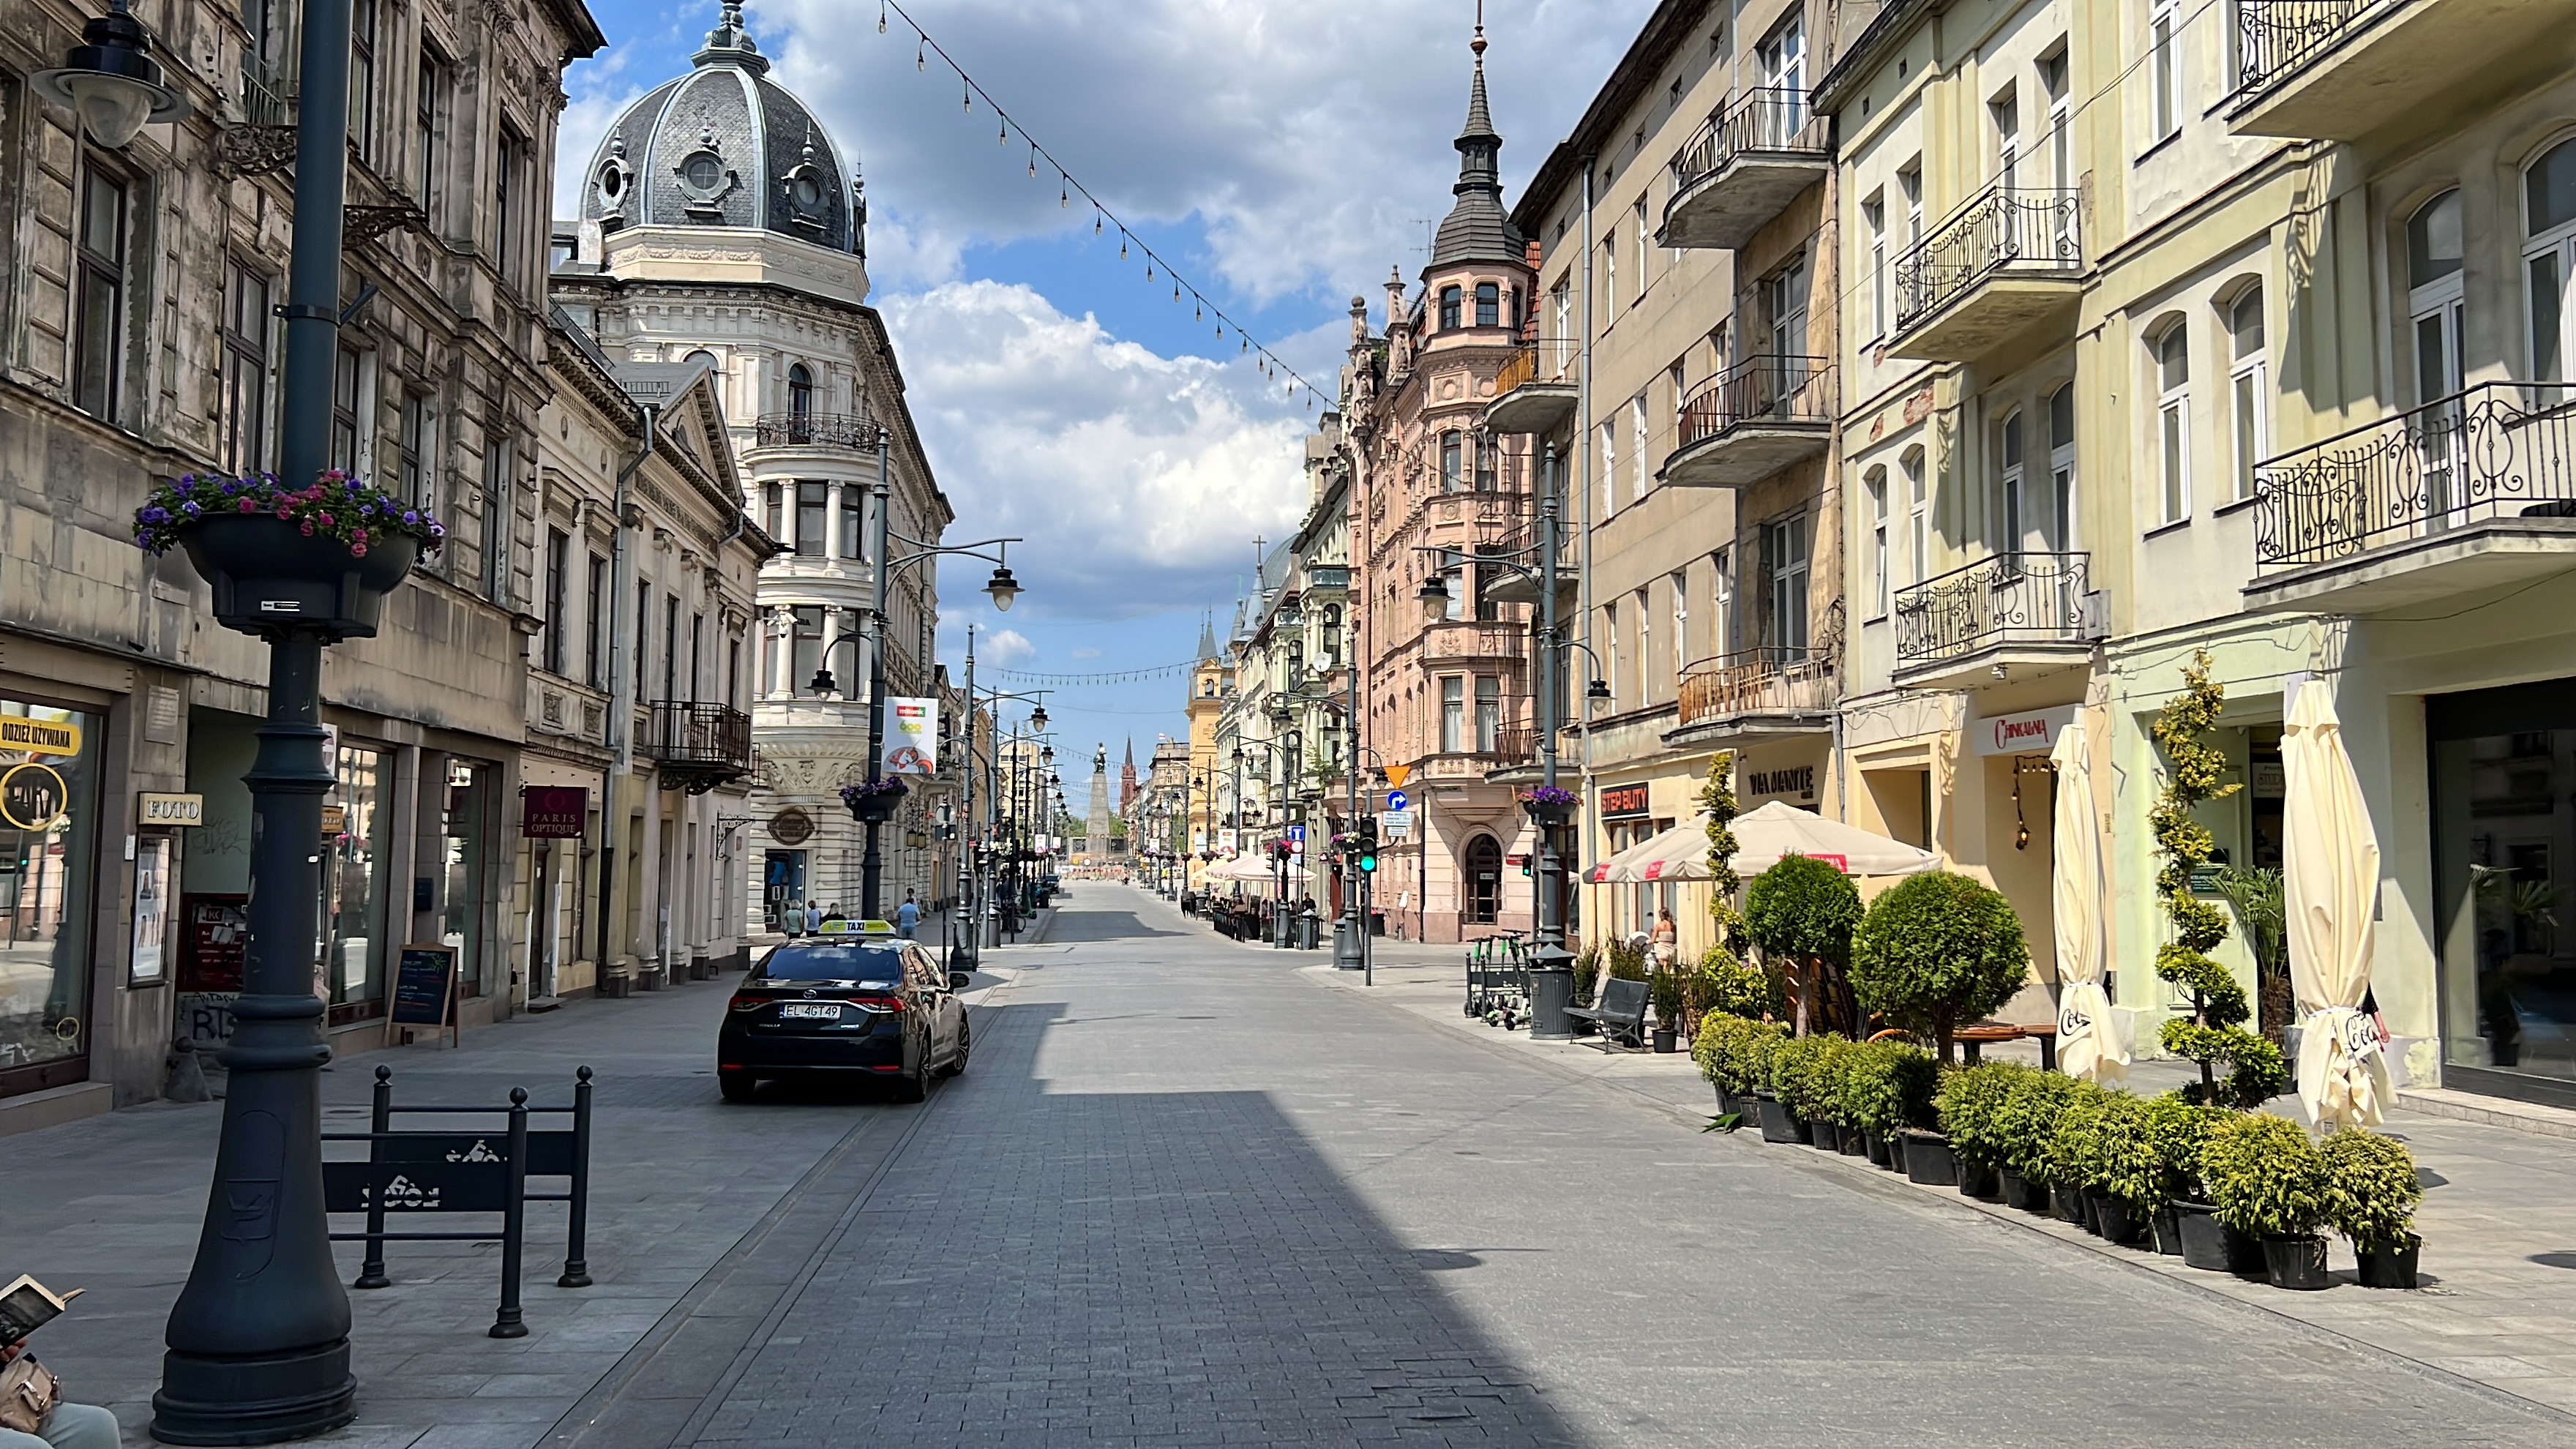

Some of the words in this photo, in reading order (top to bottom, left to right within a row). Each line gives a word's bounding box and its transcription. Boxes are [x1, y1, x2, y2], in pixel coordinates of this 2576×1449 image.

[899, 720, 922, 732] 600
[1, 722, 31, 742] ODZIEŻ
[31, 723, 70, 749] UŻYWANA
[1601, 791, 1622, 812] STEP
[1622, 787, 1647, 810] BUTY
[147, 800, 199, 820] FOTO
[532, 813, 576, 823] PARIS
[531, 823, 576, 834] OPTIQUE
[847, 921, 865, 931] TAXI
[786, 1005, 800, 1016] EL
[804, 1006, 838, 1017] 4GT49
